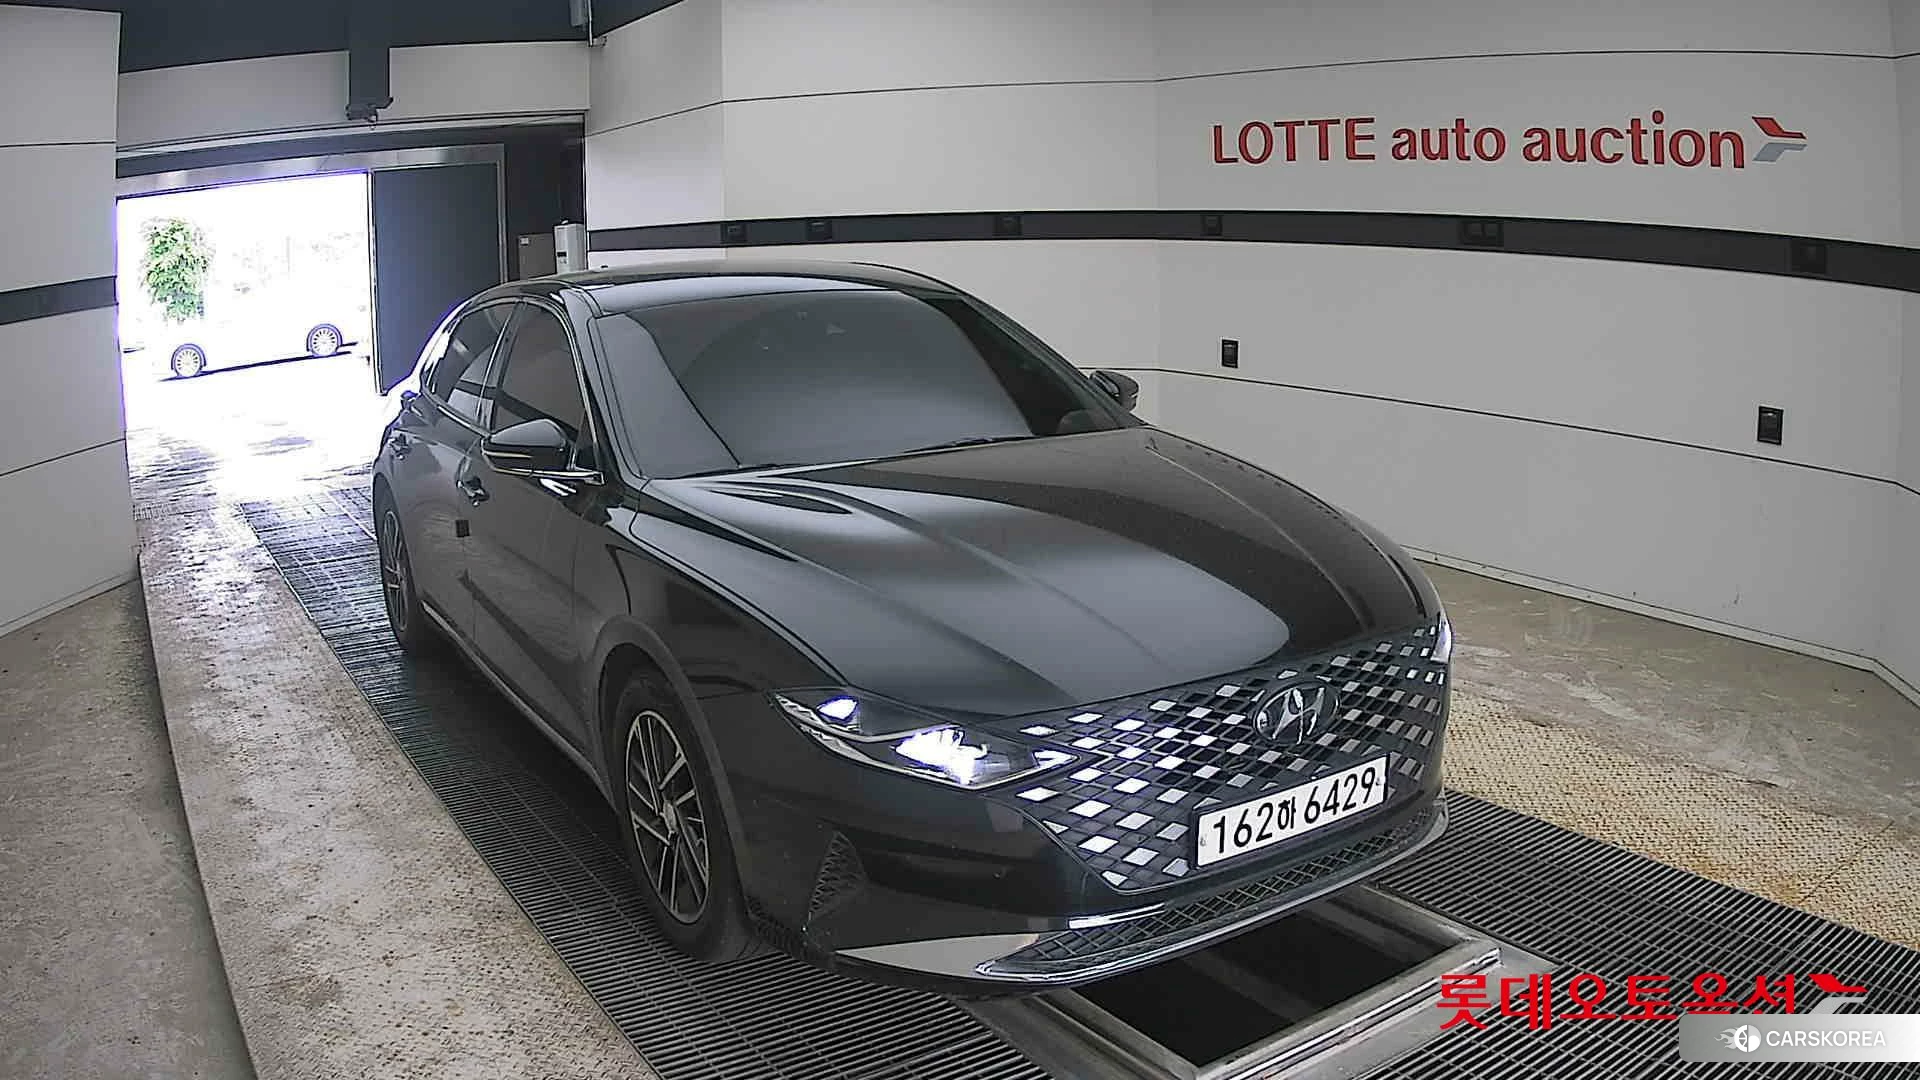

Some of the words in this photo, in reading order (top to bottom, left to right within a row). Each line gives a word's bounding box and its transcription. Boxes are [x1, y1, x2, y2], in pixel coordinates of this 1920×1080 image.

[1213, 117, 1376, 164] LOTTE
[1391, 118, 1506, 162] auto
[1522, 110, 1745, 169] auction
[1304, 766, 1376, 825] 6429
